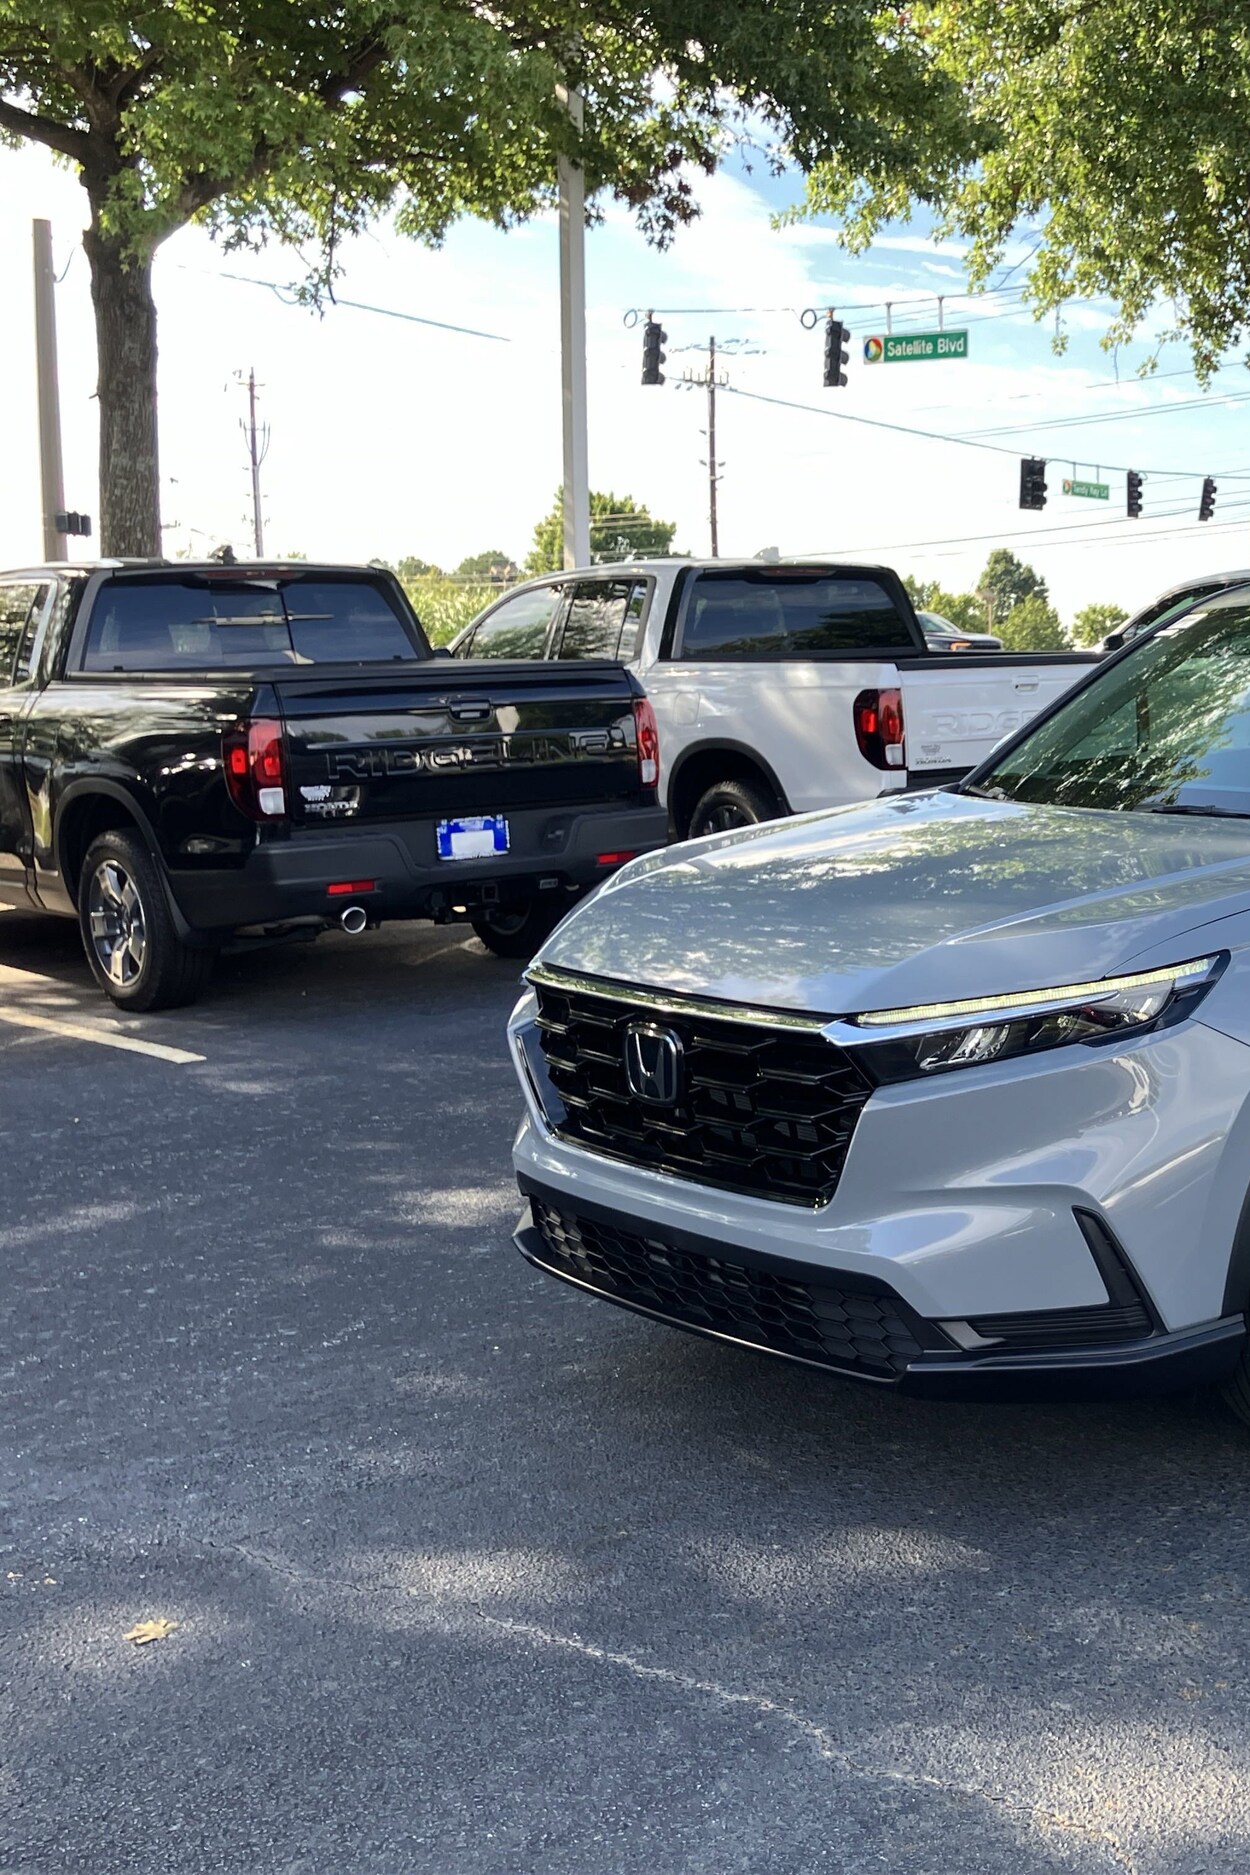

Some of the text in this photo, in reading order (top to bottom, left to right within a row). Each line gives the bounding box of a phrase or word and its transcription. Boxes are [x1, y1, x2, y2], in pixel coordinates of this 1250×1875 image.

[887, 337, 965, 357] Satellite Blvd
[931, 709, 1044, 738] RIDG
[326, 730, 610, 780] RIDGELINE
